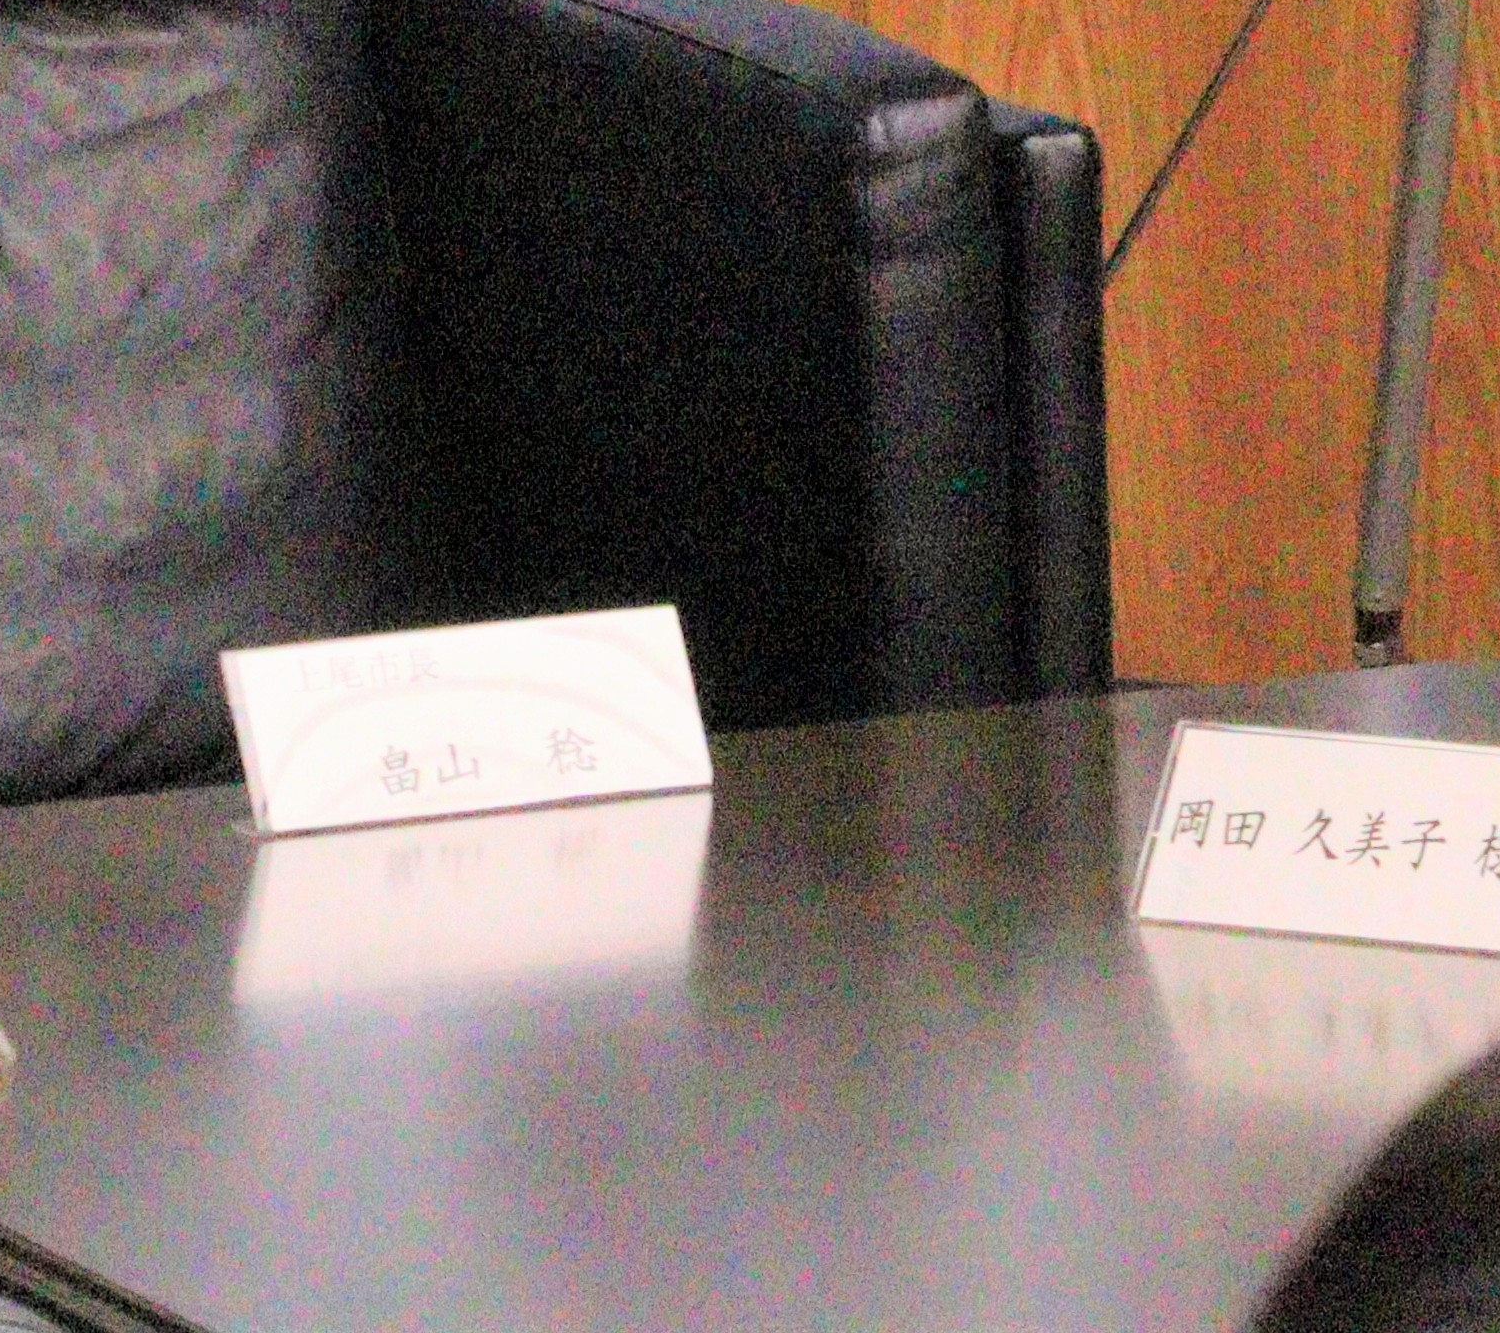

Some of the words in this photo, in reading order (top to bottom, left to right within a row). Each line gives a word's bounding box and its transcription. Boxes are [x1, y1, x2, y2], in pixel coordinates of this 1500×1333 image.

[379, 743, 482, 796] 畠山
[1170, 800, 1266, 849] 岡田
[1294, 809, 1447, 870] 久美子
